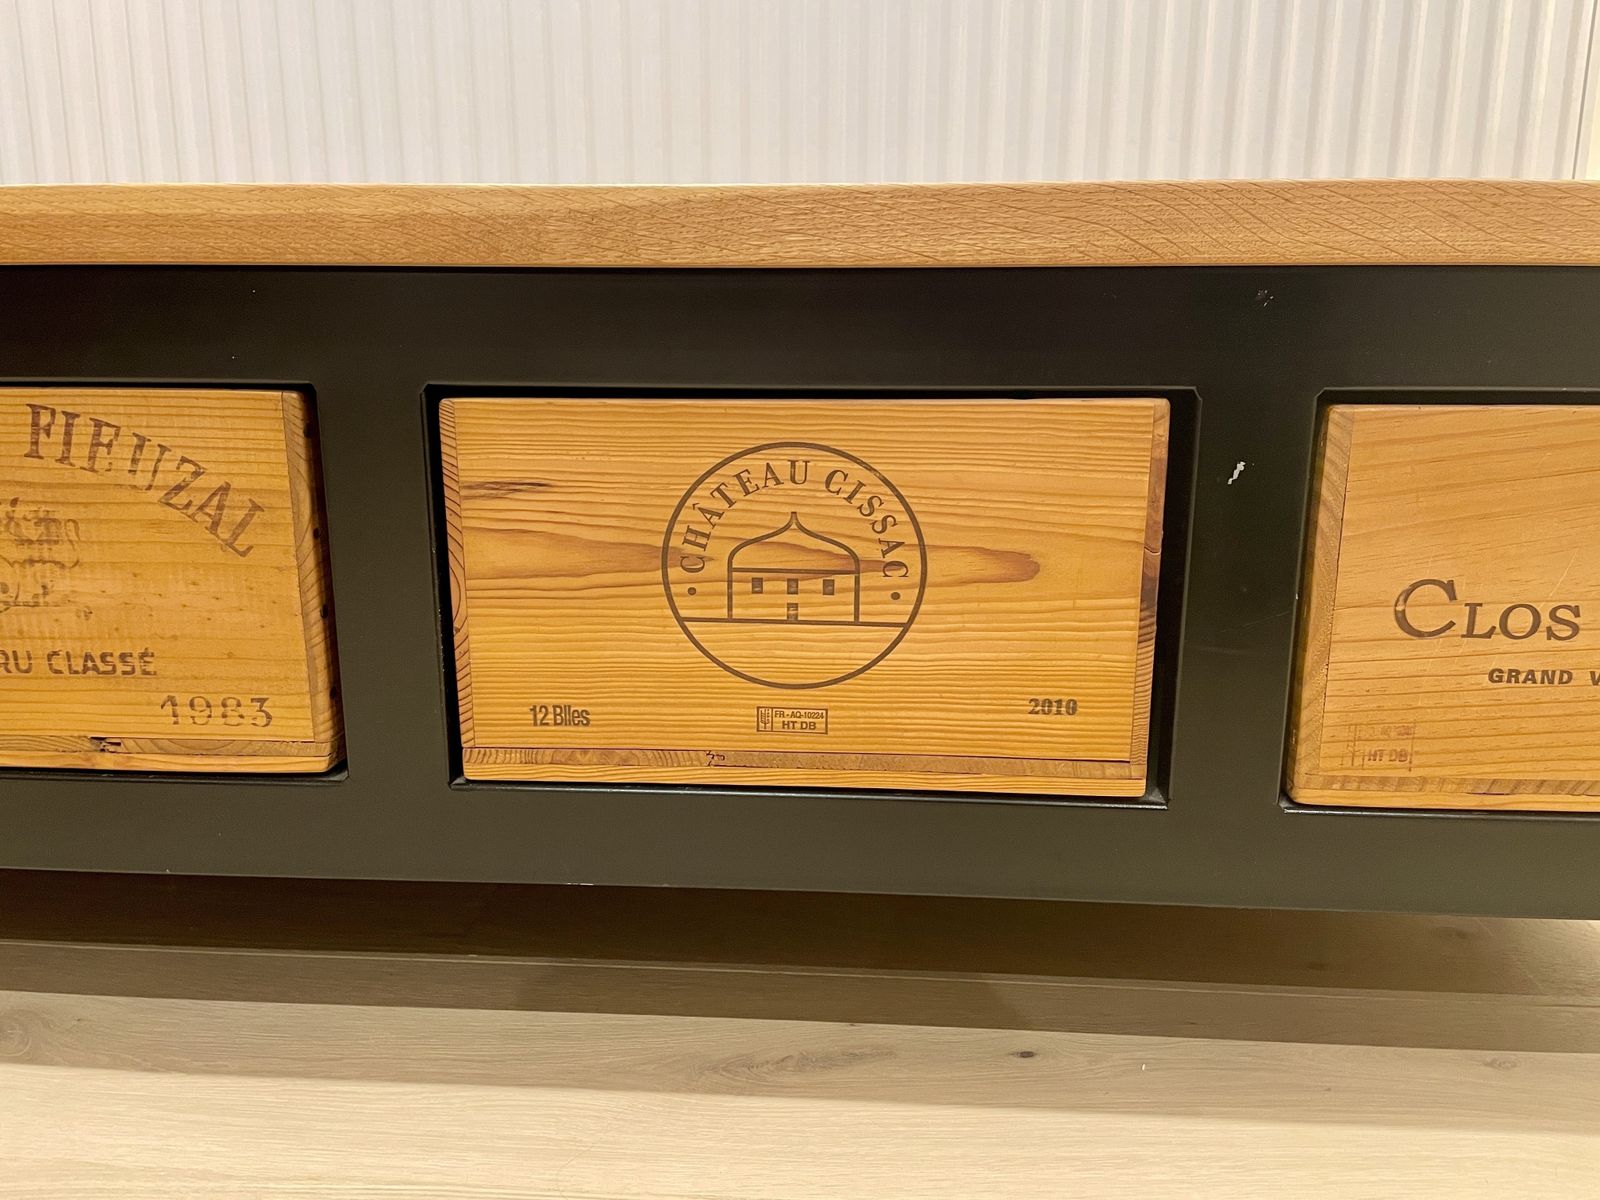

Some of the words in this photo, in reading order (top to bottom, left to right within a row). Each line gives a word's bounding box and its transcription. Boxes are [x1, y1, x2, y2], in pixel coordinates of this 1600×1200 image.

[24, 403, 265, 558] FIEUZAL
[680, 459, 810, 574] CHÂTEAU
[824, 469, 909, 578] CISSAC
[1394, 578, 1581, 641] CLOS
[47, 647, 158, 676] CLASSÉ
[1487, 668, 1573, 685] GRAND
[160, 694, 273, 728] 1983
[529, 704, 550, 727] 12
[1028, 697, 1078, 716] 2010
[781, 720, 798, 730] HT
[800, 721, 817, 731] DB
